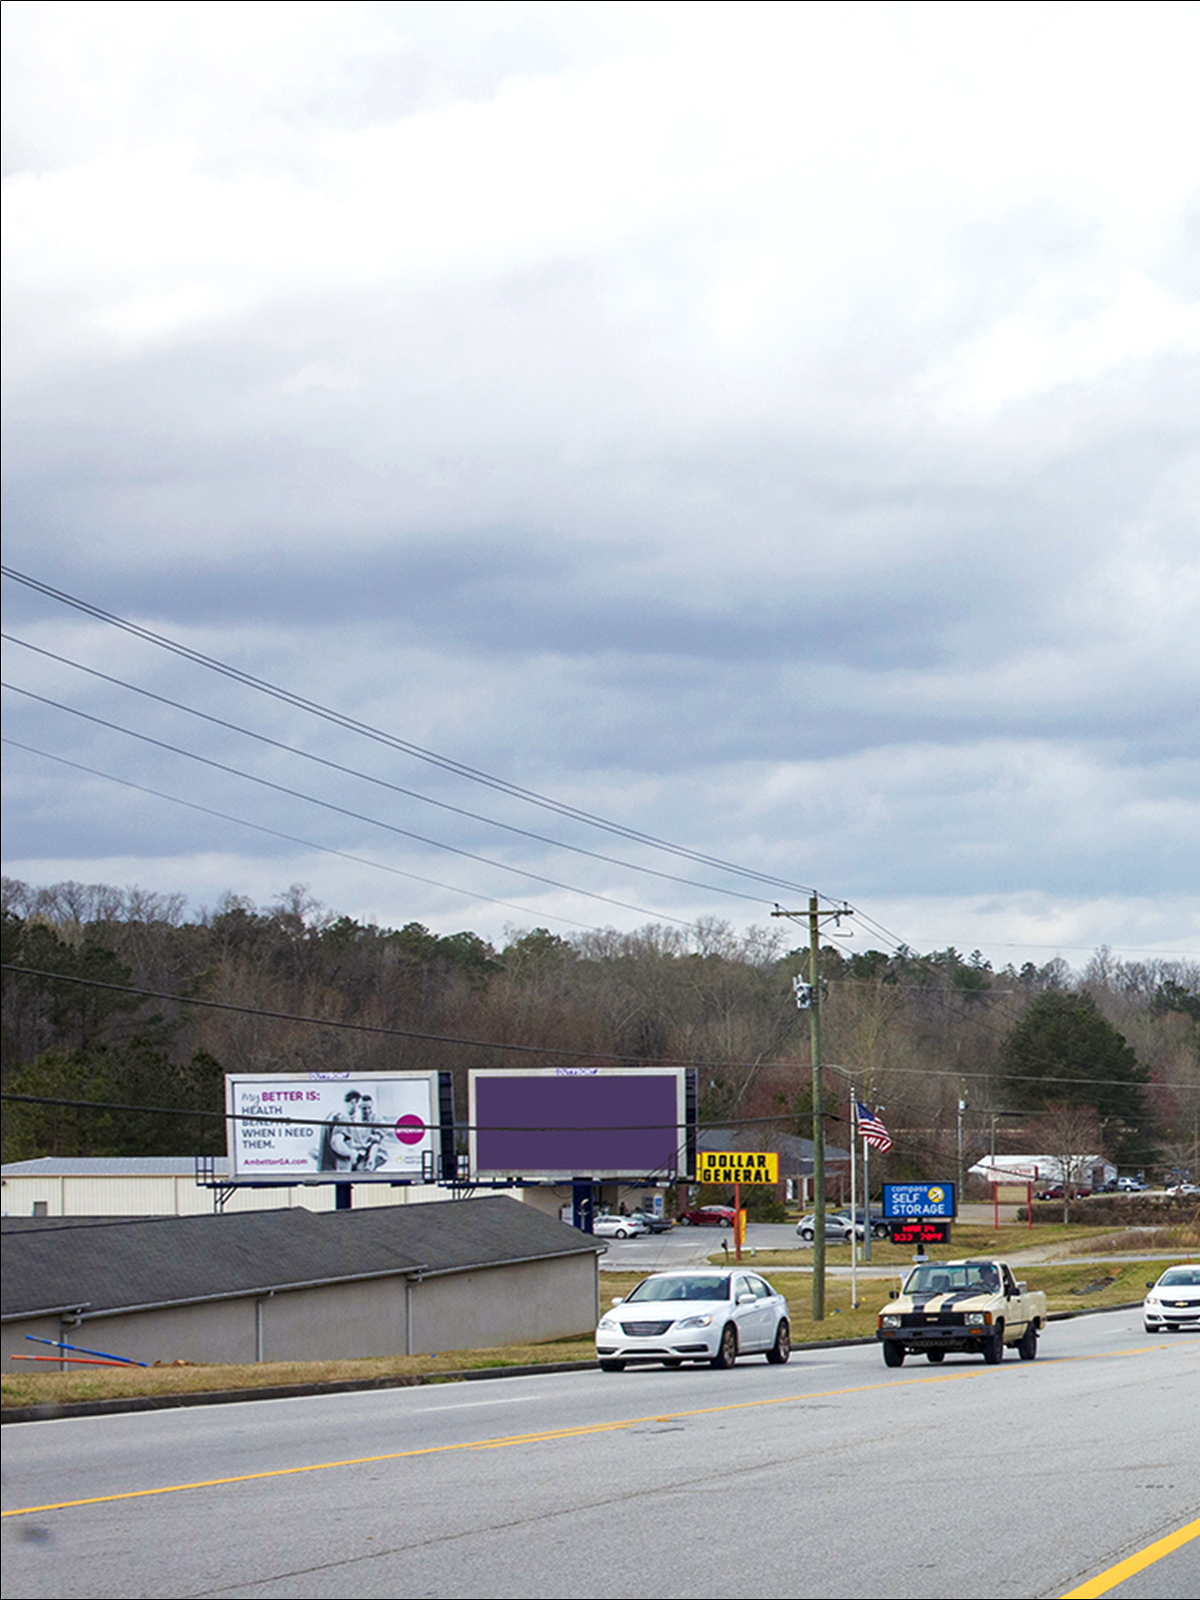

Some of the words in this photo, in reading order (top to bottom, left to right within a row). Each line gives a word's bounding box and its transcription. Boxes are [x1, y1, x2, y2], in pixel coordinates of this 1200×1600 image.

[261, 1091, 303, 1101] BETTER
[306, 1091, 320, 1101] IS:
[241, 1106, 283, 1115] HEALTH
[242, 1128, 276, 1138] WHEN
[285, 1127, 314, 1137] NEED
[242, 1140, 276, 1149] THEM.
[243, 1158, 308, 1166] AmbetterGA.com
[707, 1155, 766, 1168] DOLLAR
[703, 1169, 772, 1182] GENERAL
[891, 1186, 928, 1194] compass
[892, 1193, 920, 1203] SELF
[892, 1204, 945, 1215] STORAGE
